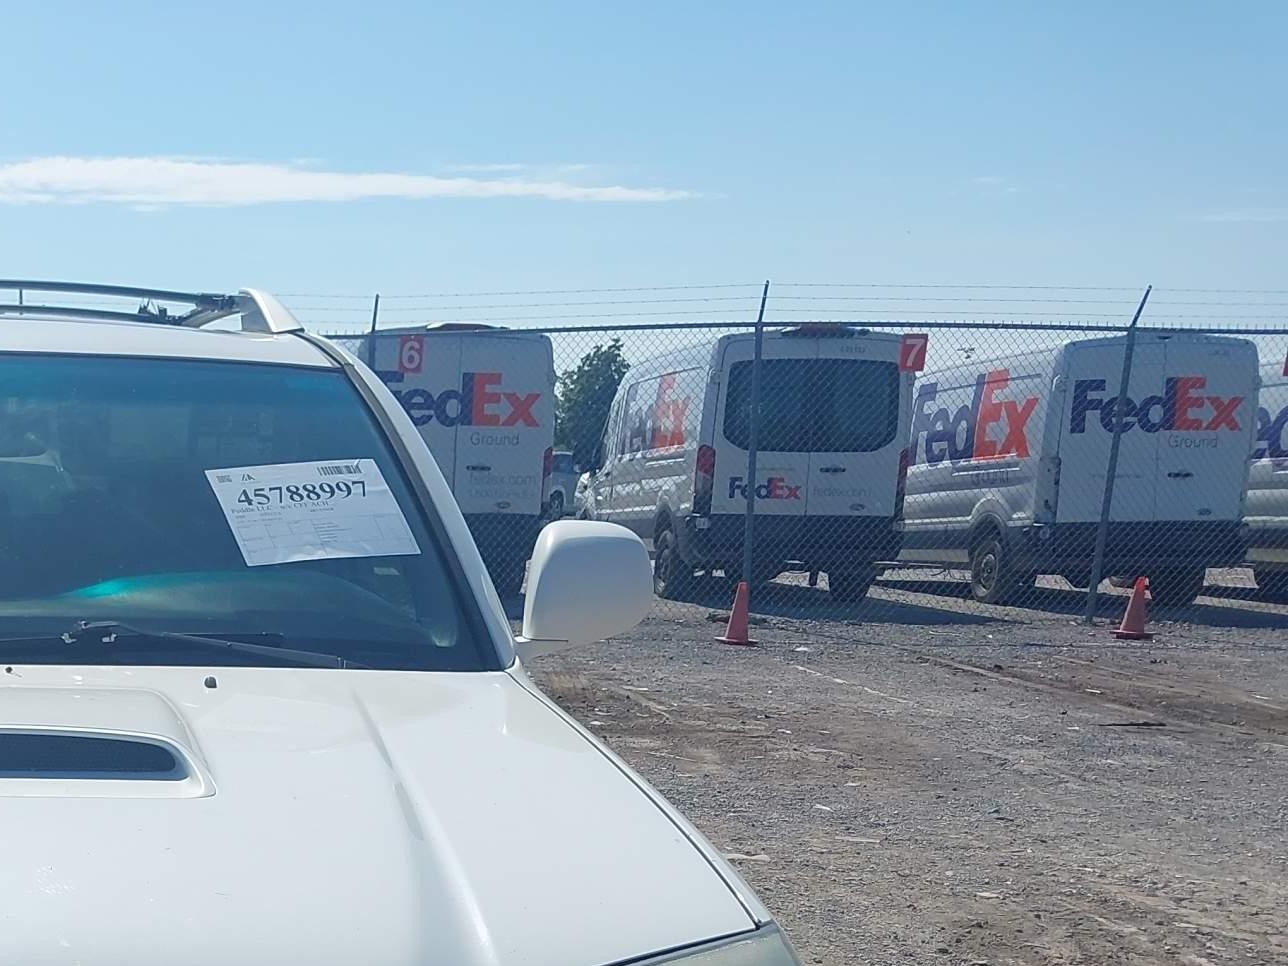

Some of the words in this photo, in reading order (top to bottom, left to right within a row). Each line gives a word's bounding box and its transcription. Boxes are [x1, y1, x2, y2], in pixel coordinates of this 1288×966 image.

[402, 341, 420, 369] 6
[904, 339, 924, 367] 7
[911, 368, 1040, 467] FedEx
[1070, 376, 1247, 434] FedEx
[470, 431, 520, 446] Ground
[1168, 434, 1219, 449] Ground
[238, 480, 366, 506] 45788997
